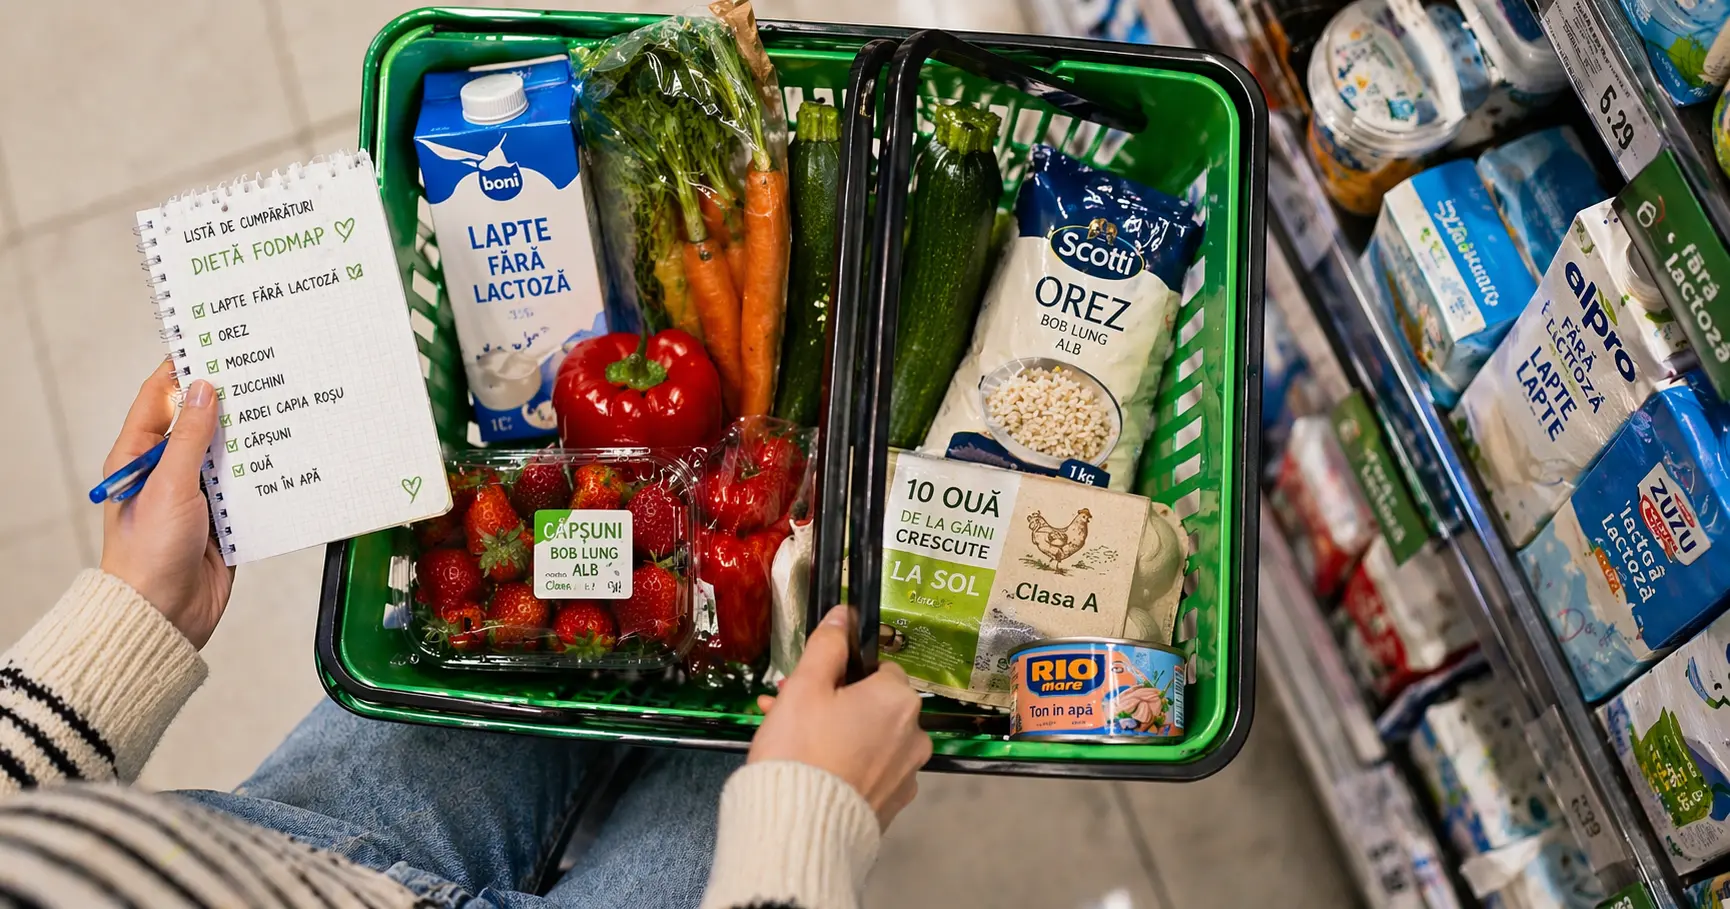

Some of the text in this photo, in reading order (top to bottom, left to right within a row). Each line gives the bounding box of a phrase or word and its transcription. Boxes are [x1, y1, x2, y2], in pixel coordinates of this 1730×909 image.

[1600, 84, 1634, 150] 6.29
[482, 172, 520, 191] boni
[184, 199, 314, 243] LISTĂ DE CUMPĂRĂTURI
[468, 217, 551, 250] LAPTE
[191, 226, 325, 275] DIETĂ FODMAP
[487, 246, 545, 276] FĂRĂ
[1058, 231, 1136, 275] Scotti
[211, 268, 340, 314] LAPTE FĂRĂ LACTOZĂ
[473, 269, 572, 304] LACTOZĂ
[1035, 276, 1132, 332] OREZ
[218, 324, 250, 342] OREZ
[1040, 314, 1108, 346] BOB LUNG
[1565, 261, 1636, 383] alpro
[226, 346, 275, 369] MORCOVI
[1055, 338, 1082, 356] ALB
[1561, 316, 1597, 373] FĂRĂ
[232, 374, 285, 397] ZUCCHINI
[1530, 345, 1578, 422] LAPTE
[239, 405, 271, 424] ARDEI
[276, 396, 309, 414] CAPIA
[1516, 360, 1565, 442] LAPTE
[250, 454, 274, 473] OUĂ
[255, 468, 321, 497] TON ÎN APĂ
[907, 478, 1001, 518] 10 OUĂ
[901, 510, 995, 540] DE LA GĂINI
[1650, 477, 1697, 554] ZUZU
[550, 547, 618, 560] BOB LUNG
[896, 529, 990, 560] CRESCUTE
[572, 563, 599, 577] ALB
[890, 560, 980, 597] LA SOL
[1015, 582, 1099, 613] Clasa A
[1032, 658, 1098, 682] RIO
[1041, 681, 1083, 692] mare
[1029, 705, 1049, 718] Ton
[1053, 703, 1064, 716] in
